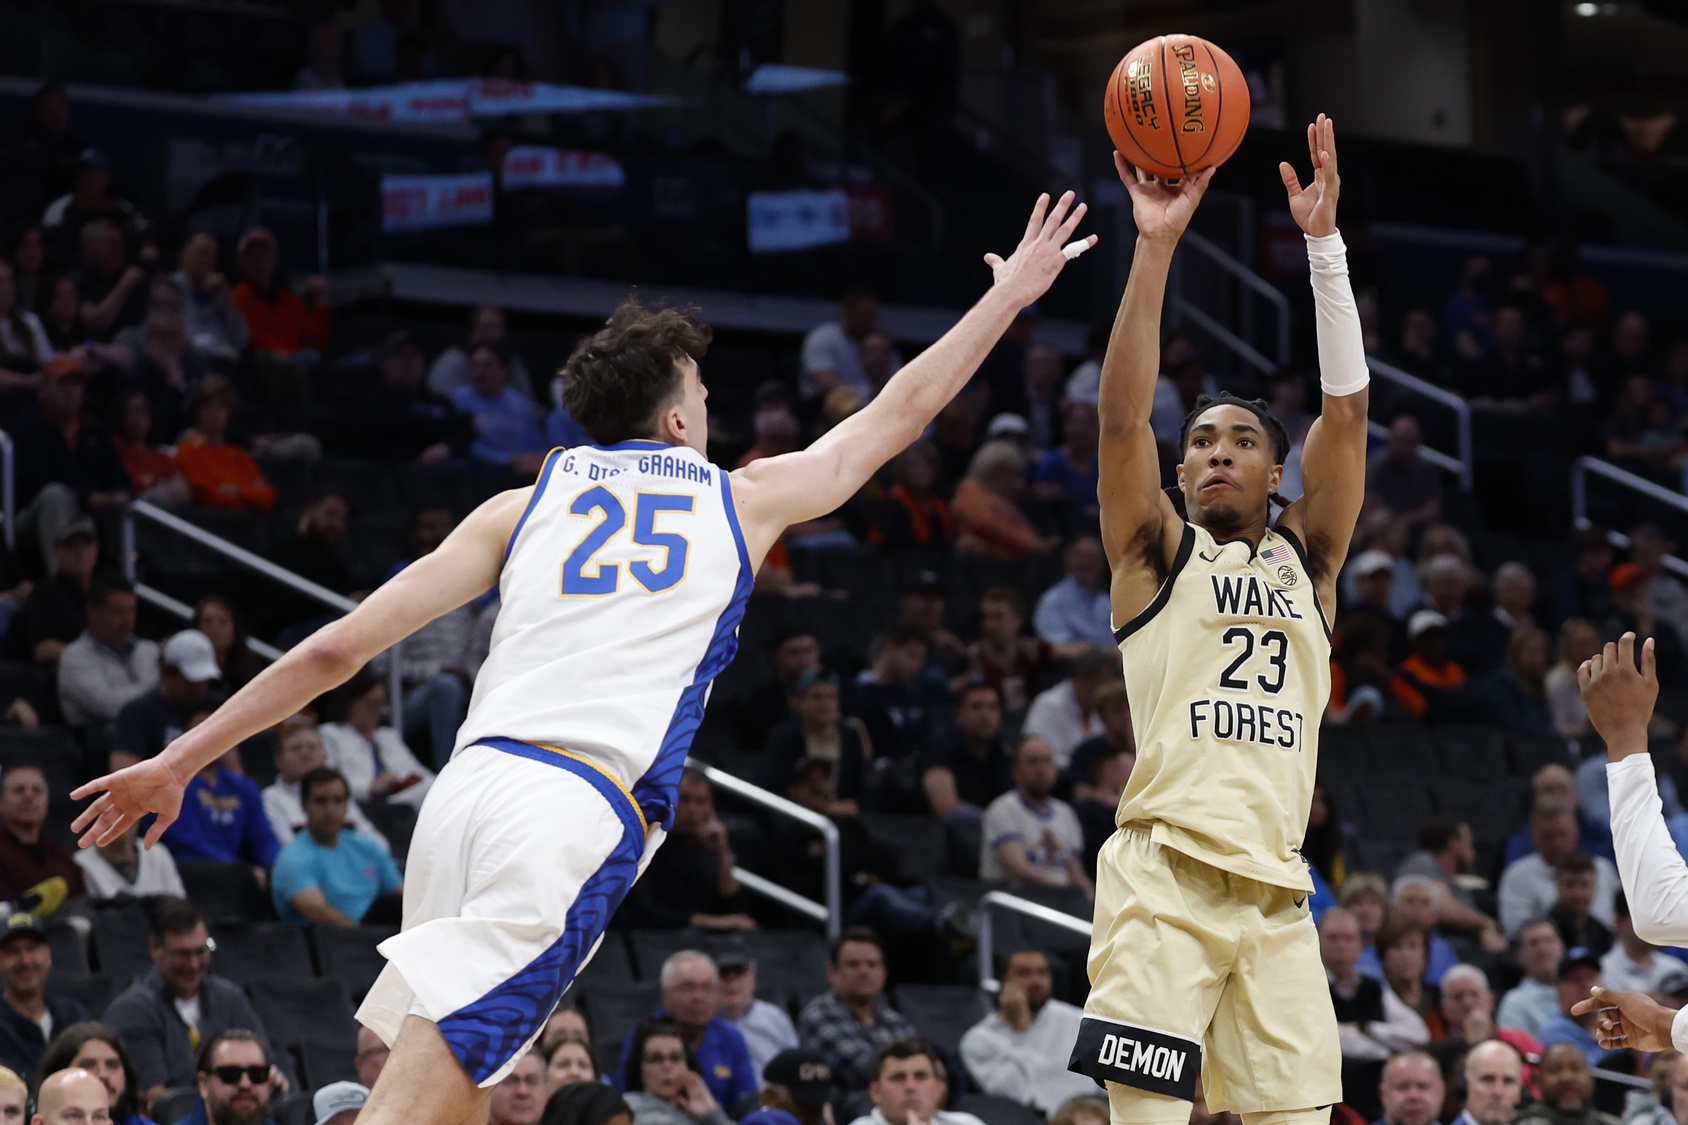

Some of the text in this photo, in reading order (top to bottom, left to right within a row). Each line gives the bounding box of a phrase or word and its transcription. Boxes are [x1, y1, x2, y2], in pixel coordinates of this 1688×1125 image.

[1138, 52, 1161, 130] LEGACY
[1172, 45, 1205, 133] SPALDING
[562, 455, 579, 476] G.
[639, 454, 712, 486] GRAHAM
[558, 483, 697, 598] 25
[1209, 573, 1304, 620] WAKE
[1219, 627, 1288, 695] 23
[1097, 1033, 1187, 1083] DEMON
